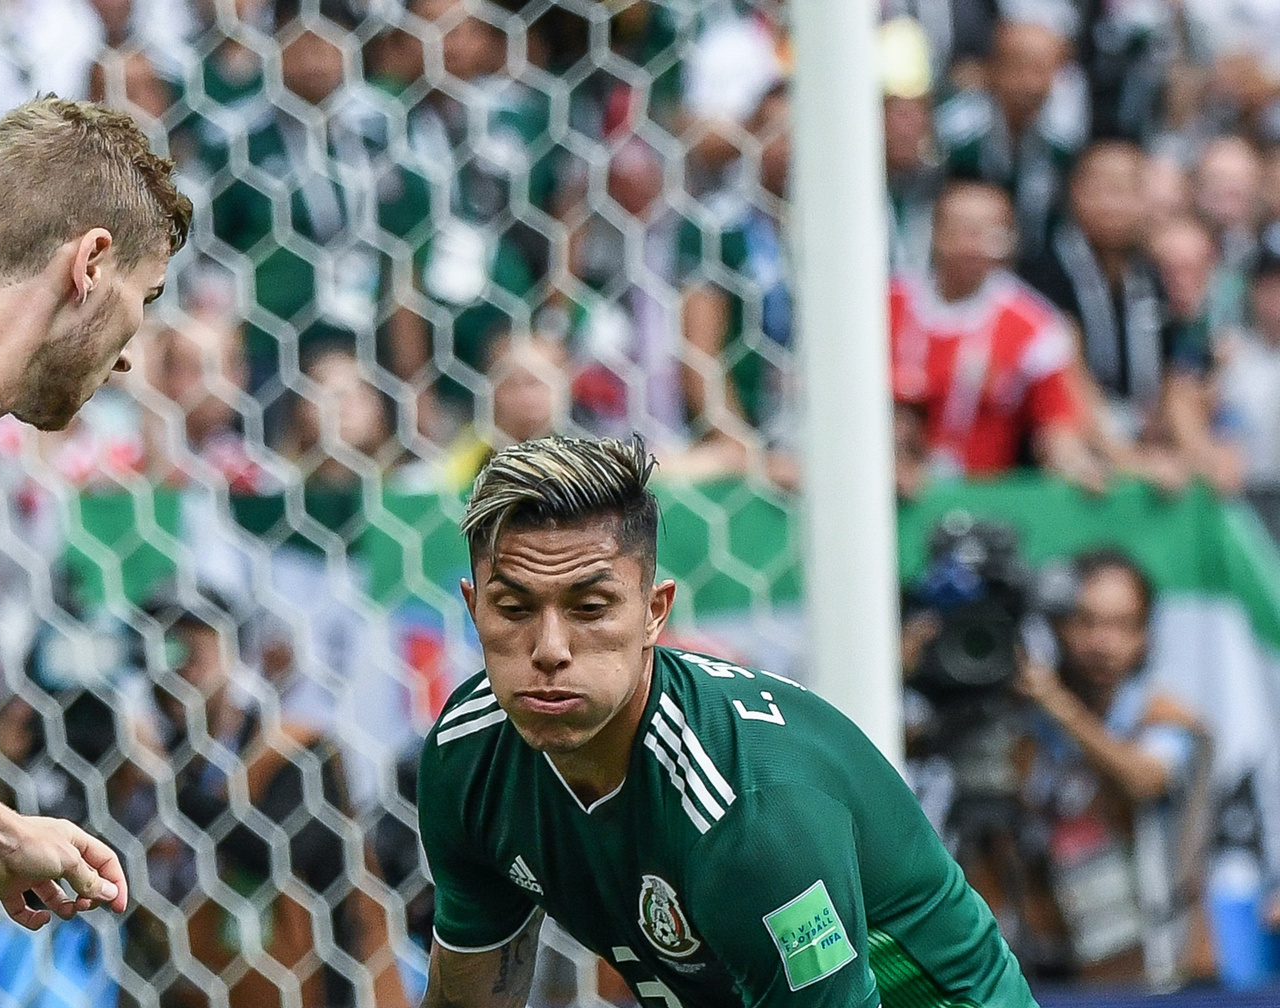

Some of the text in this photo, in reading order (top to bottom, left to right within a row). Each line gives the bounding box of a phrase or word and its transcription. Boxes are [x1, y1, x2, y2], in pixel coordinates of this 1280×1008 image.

[781, 907, 830, 944] LIVING
[785, 917, 834, 953] FOOTBALL
[820, 932, 842, 950] FIFA
